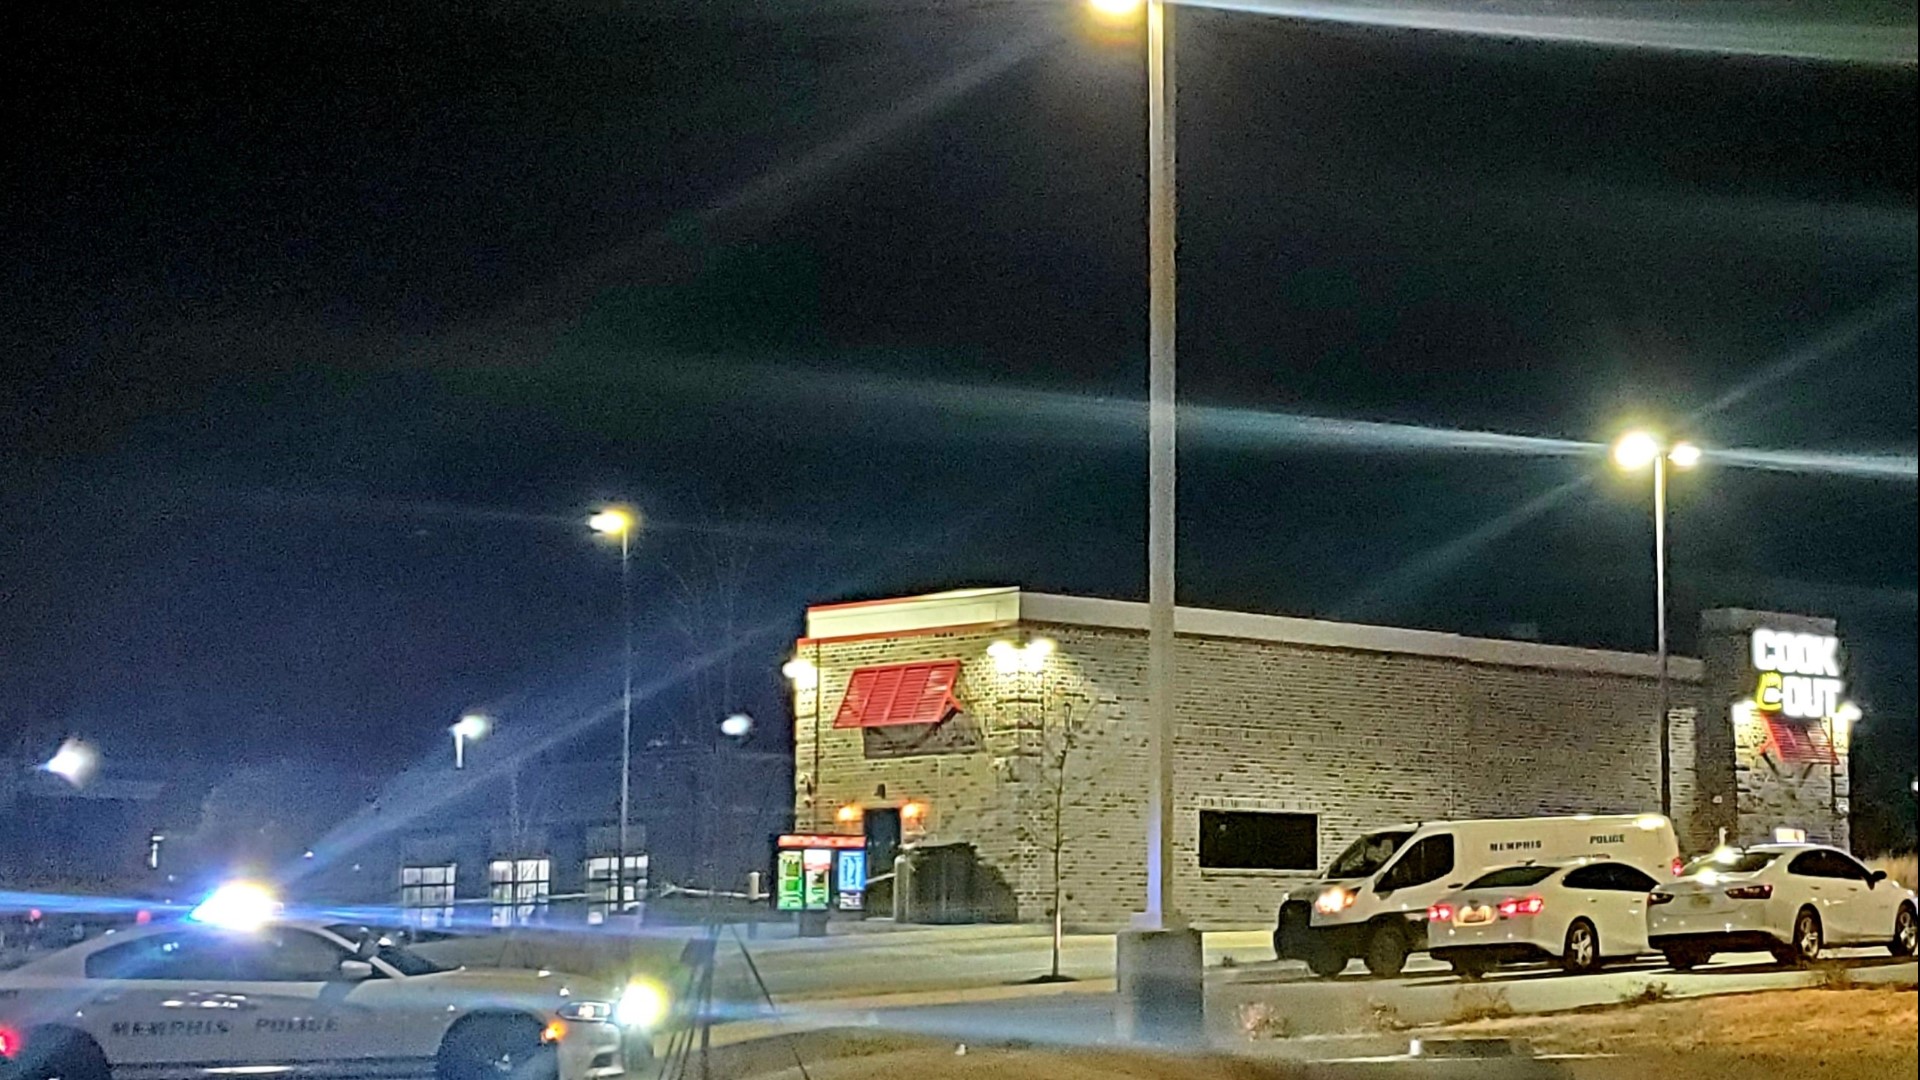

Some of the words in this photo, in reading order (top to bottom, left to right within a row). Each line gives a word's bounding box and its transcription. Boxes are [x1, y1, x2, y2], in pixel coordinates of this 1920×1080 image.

[1753, 629, 1838, 676] COOK
[1489, 840, 1542, 851] MEMPHIS
[1589, 834, 1625, 844] POLICE
[111, 1019, 231, 1037] MEMPHIS
[255, 1017, 339, 1033] POLICE
